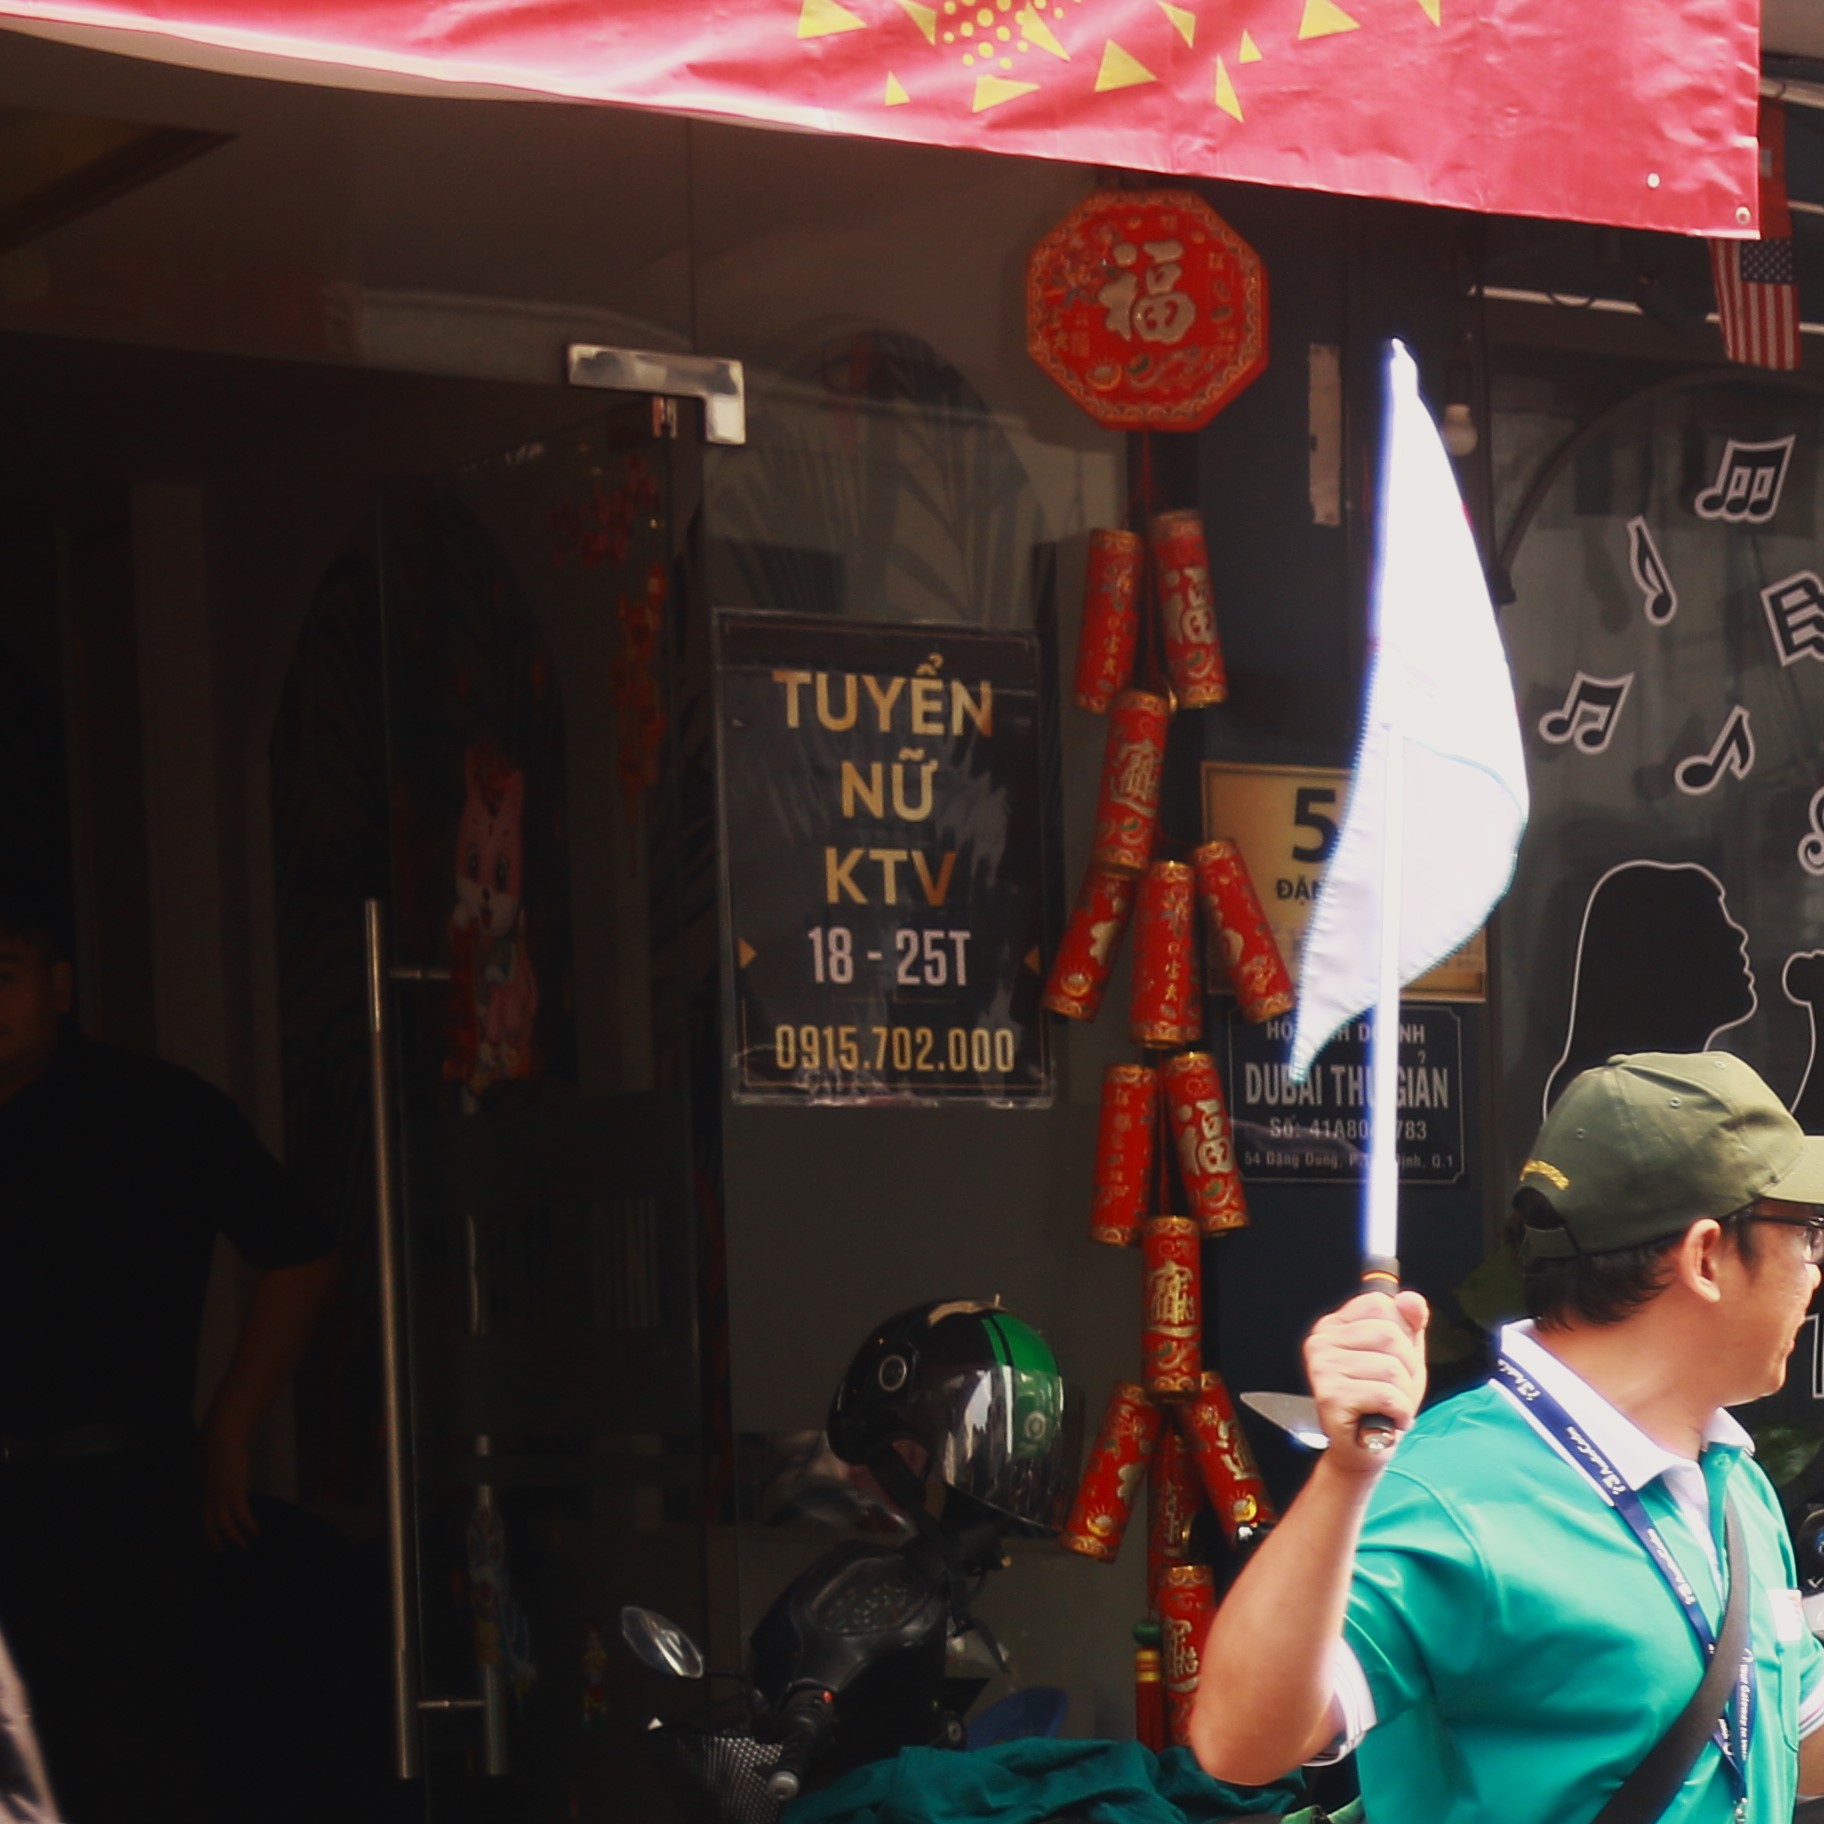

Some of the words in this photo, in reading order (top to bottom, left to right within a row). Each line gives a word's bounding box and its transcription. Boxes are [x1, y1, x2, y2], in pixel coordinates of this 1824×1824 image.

[772, 652, 993, 737] TUYỂN
[841, 747, 938, 822] NỮ
[1291, 787, 1342, 863] 5
[824, 847, 957, 907] KTV
[808, 926, 855, 984] 18
[867, 950, 882, 961] -
[895, 929, 971, 986] 25T
[774, 1024, 1015, 1072] 0915.702.000
[1309, 1118, 1427, 1140] 41A80783
